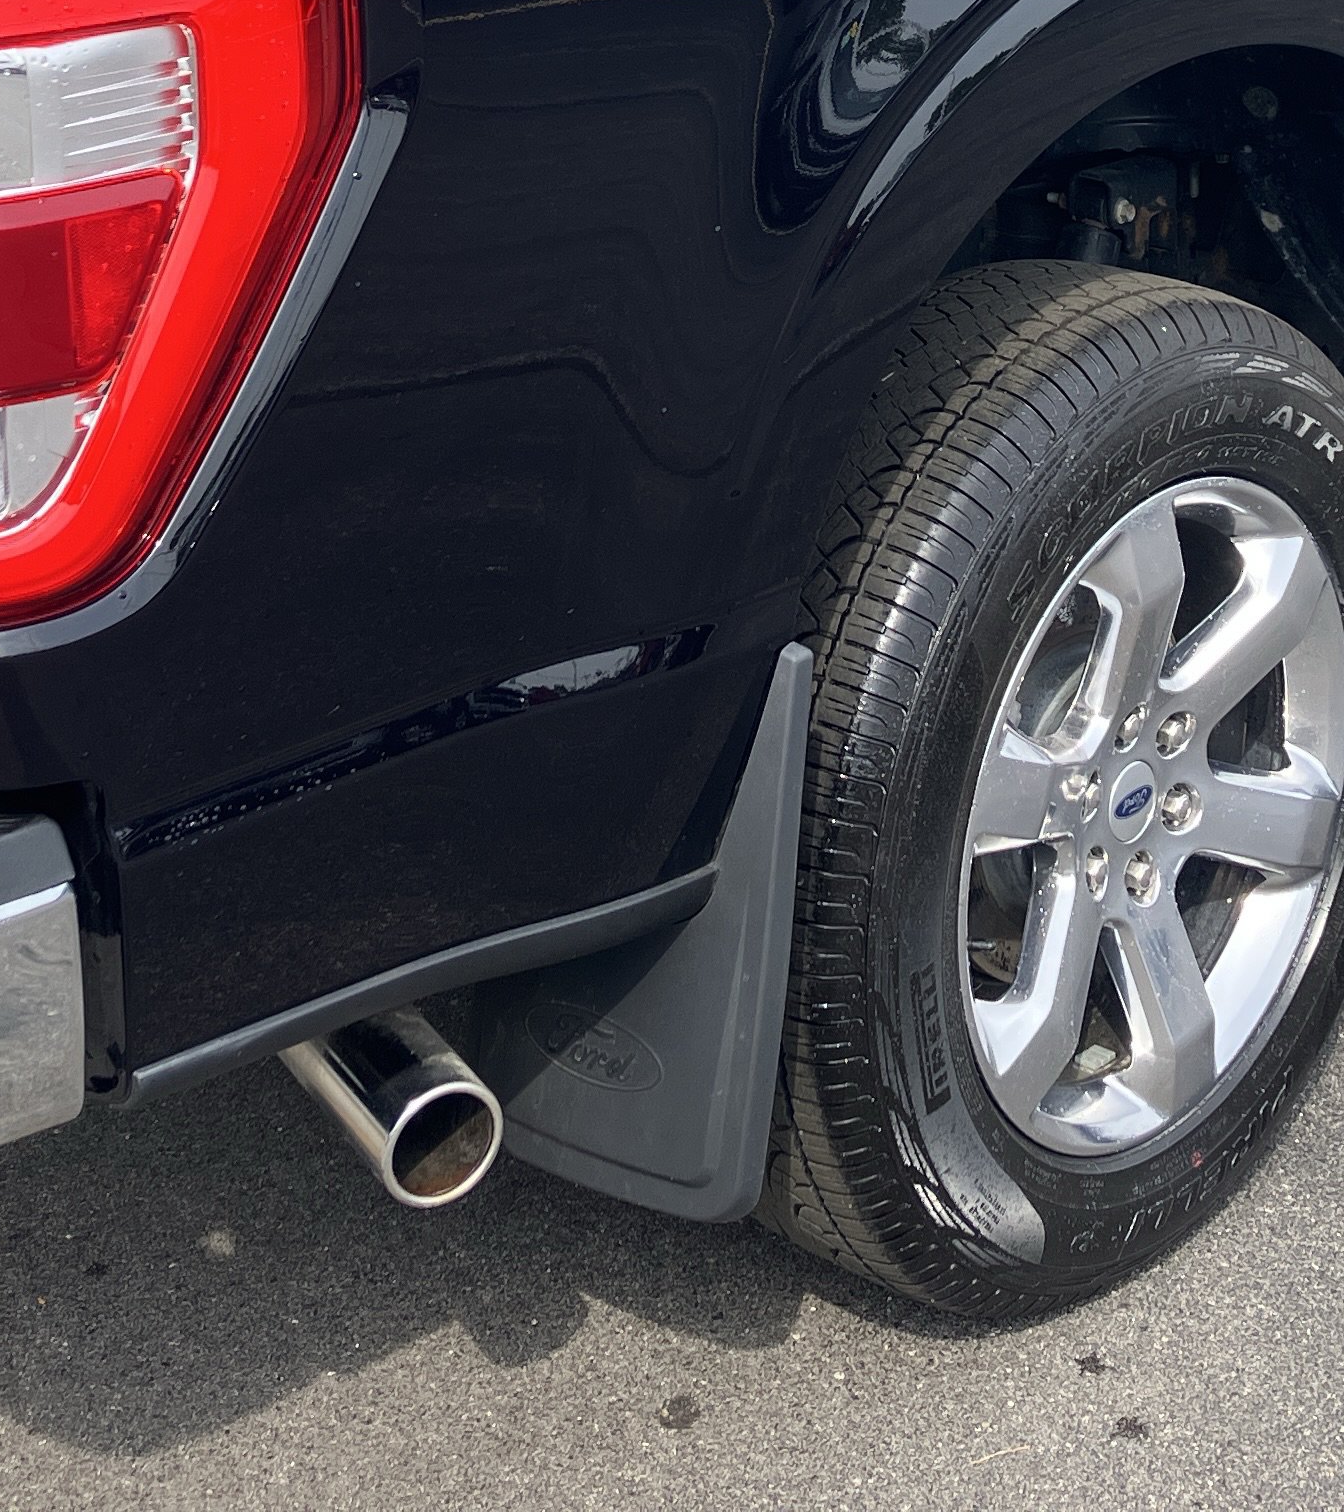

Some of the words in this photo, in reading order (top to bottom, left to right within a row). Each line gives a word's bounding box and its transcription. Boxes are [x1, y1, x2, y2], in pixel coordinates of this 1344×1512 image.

[1007, 391, 1254, 622] SCORPION
[1262, 404, 1344, 464] ATR
[548, 1014, 637, 1082] Ford
